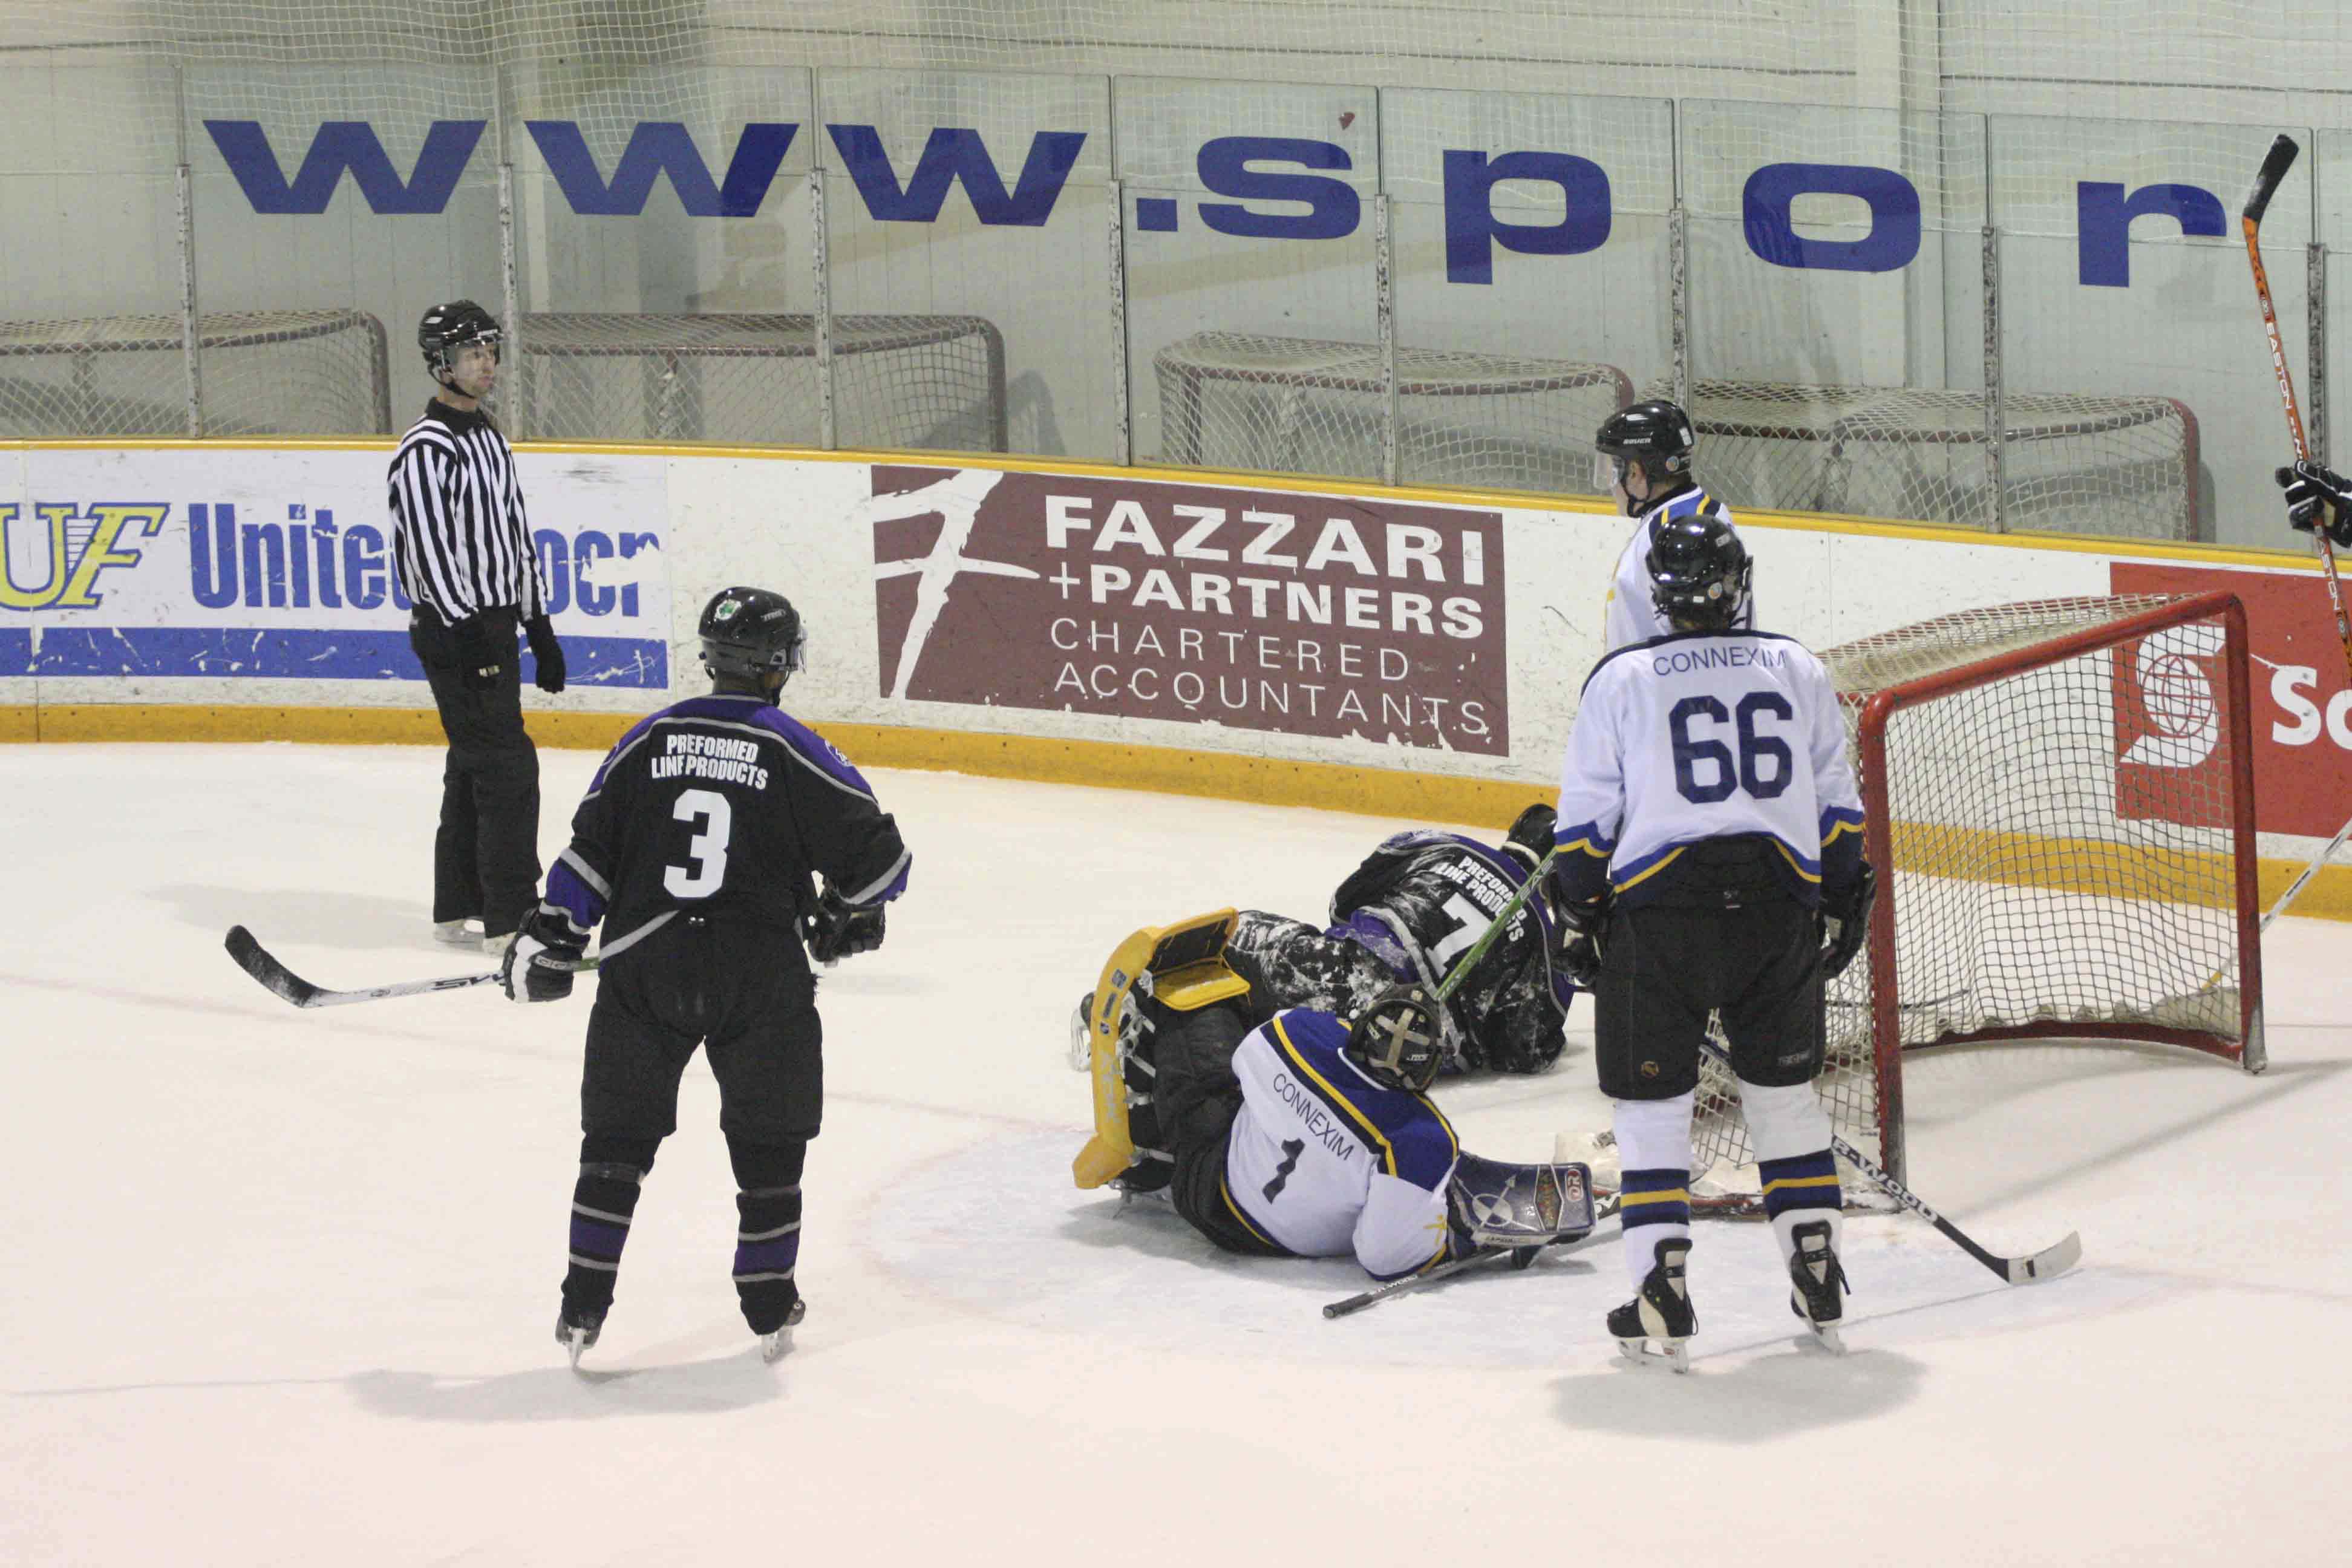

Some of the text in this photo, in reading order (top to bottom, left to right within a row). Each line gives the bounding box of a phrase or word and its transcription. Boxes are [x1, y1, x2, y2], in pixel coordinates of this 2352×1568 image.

[189, 503, 411, 610] Unite
[1045, 494, 1485, 586] FAZZARI
[1051, 617, 1409, 682] CHARTERED
[1653, 647, 1786, 676] CONNEXIM
[1054, 662, 1486, 735] ACCOUNTANTS
[666, 734, 759, 763] PREFORMED
[685, 755, 768, 790] PRODUCTS
[1668, 691, 1793, 804] 66
[663, 788, 731, 899] 3
[1425, 891, 1494, 978] 7
[1273, 1073, 1354, 1161] CONNEXIM
[1262, 1138, 1306, 1206] 1
